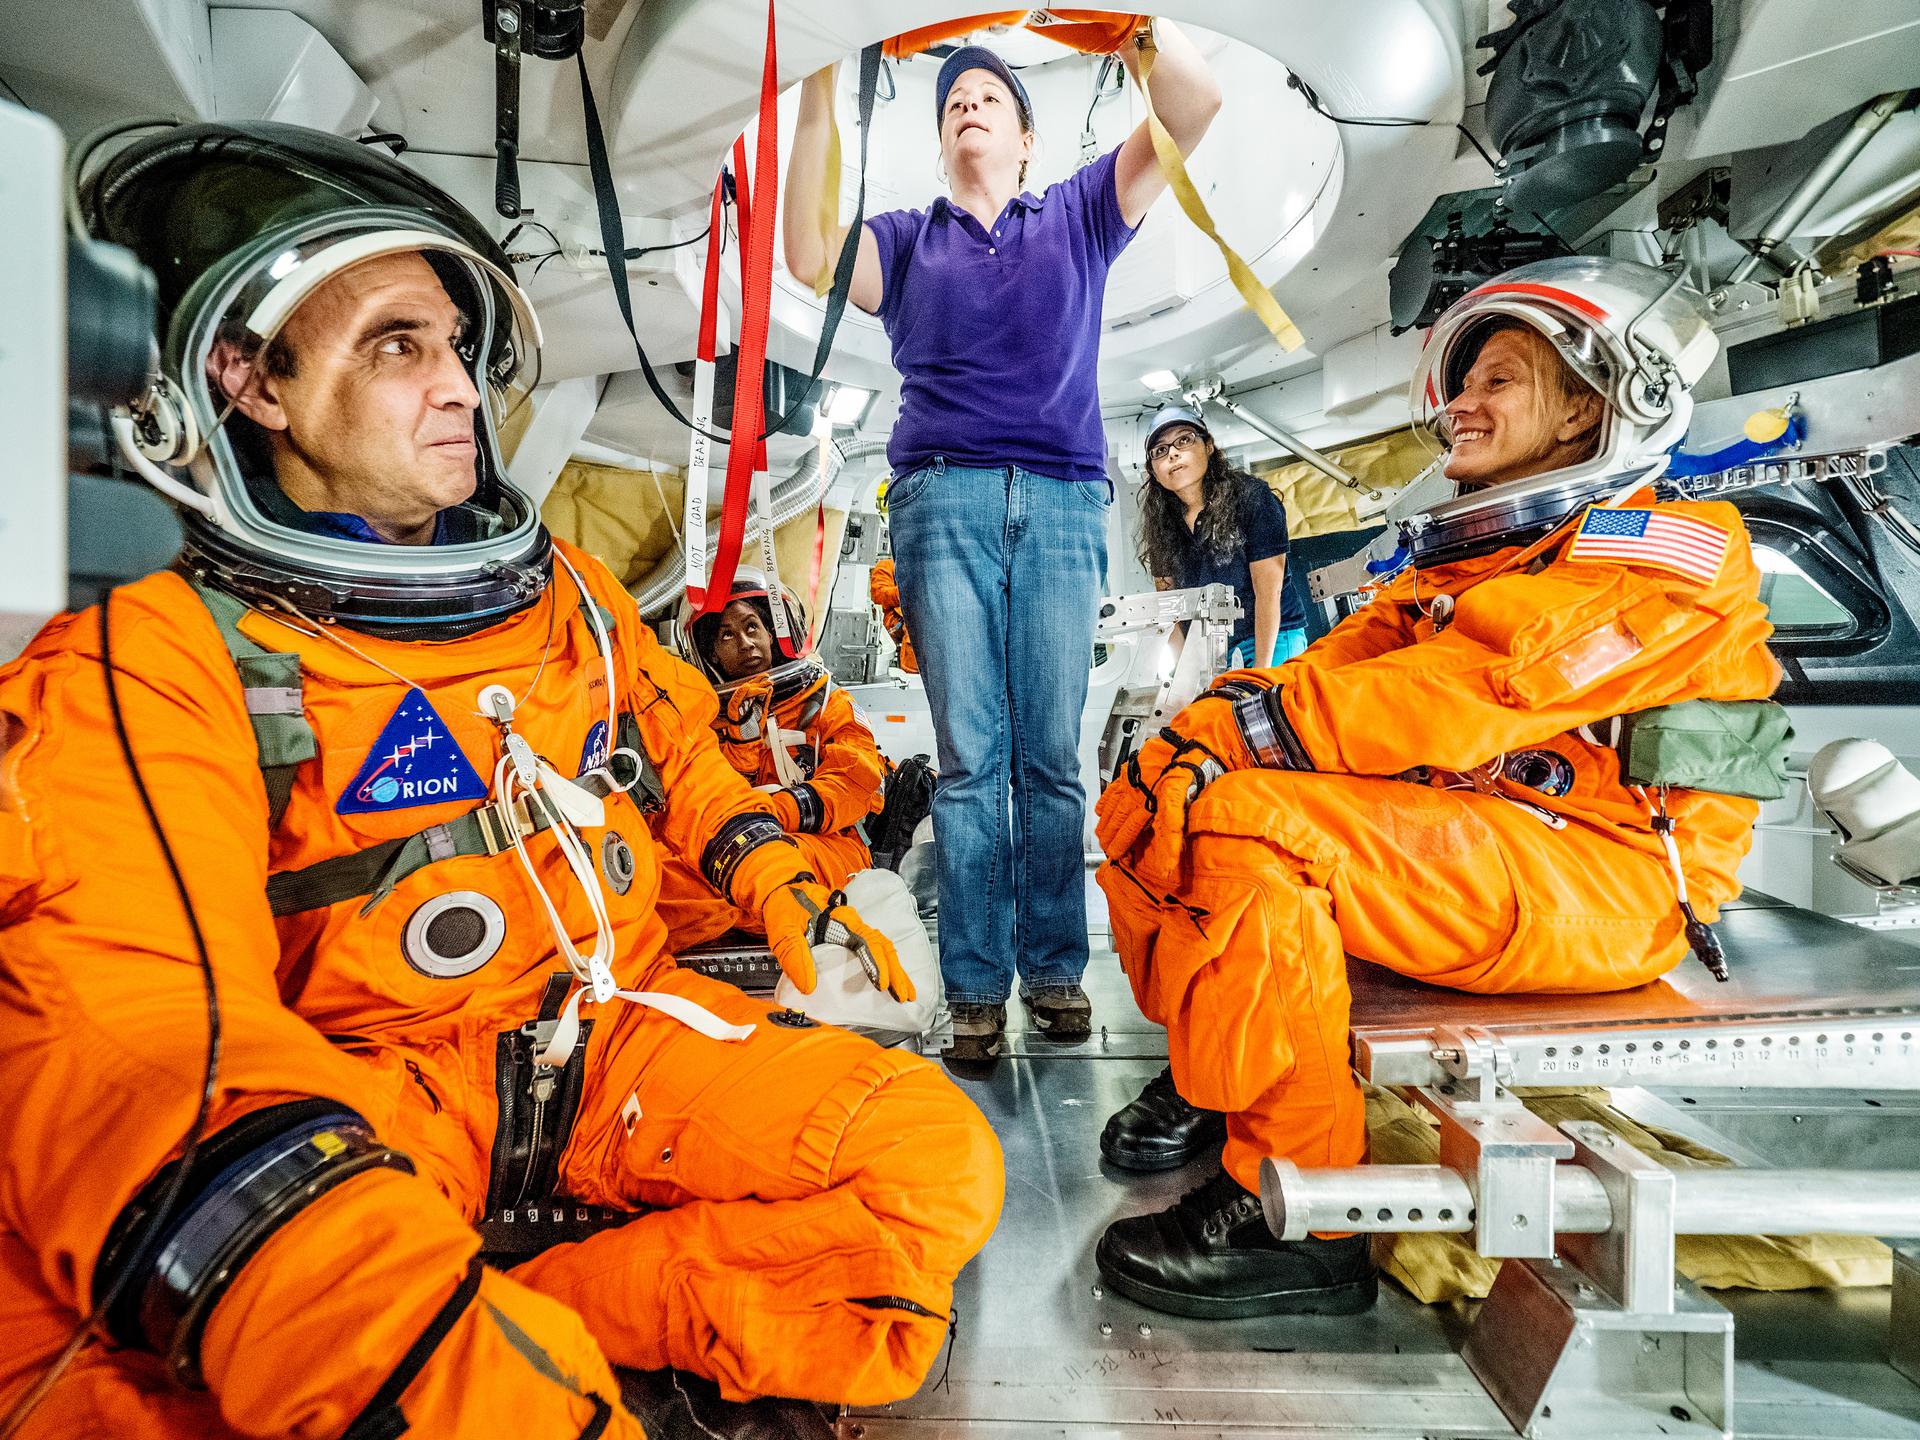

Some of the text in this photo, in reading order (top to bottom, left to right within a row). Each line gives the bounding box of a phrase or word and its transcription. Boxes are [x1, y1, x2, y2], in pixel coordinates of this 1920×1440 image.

[689, 416, 708, 570] NOT LOAD BEARING
[762, 528, 775, 573] BEARING
[771, 583, 782, 607] LOAD
[776, 613, 784, 630] NOT
[1543, 1062, 1556, 1071] 20
[1567, 1061, 1579, 1070] 19
[1597, 1059, 1609, 1068] 18
[1622, 1058, 1634, 1067] 17
[1650, 1056, 1662, 1065] 16
[1678, 1055, 1690, 1064] 15
[1704, 1053, 1716, 1062] 14
[1732, 1052, 1744, 1061] 13
[1759, 1051, 1770, 1060] 12
[1788, 1050, 1800, 1059] 11
[1815, 1048, 1828, 1057] 10
[1846, 1046, 1854, 1056] 9
[505, 1211, 512, 1221] 9
[529, 1210, 536, 1221] 8
[554, 1210, 561, 1220] 7
